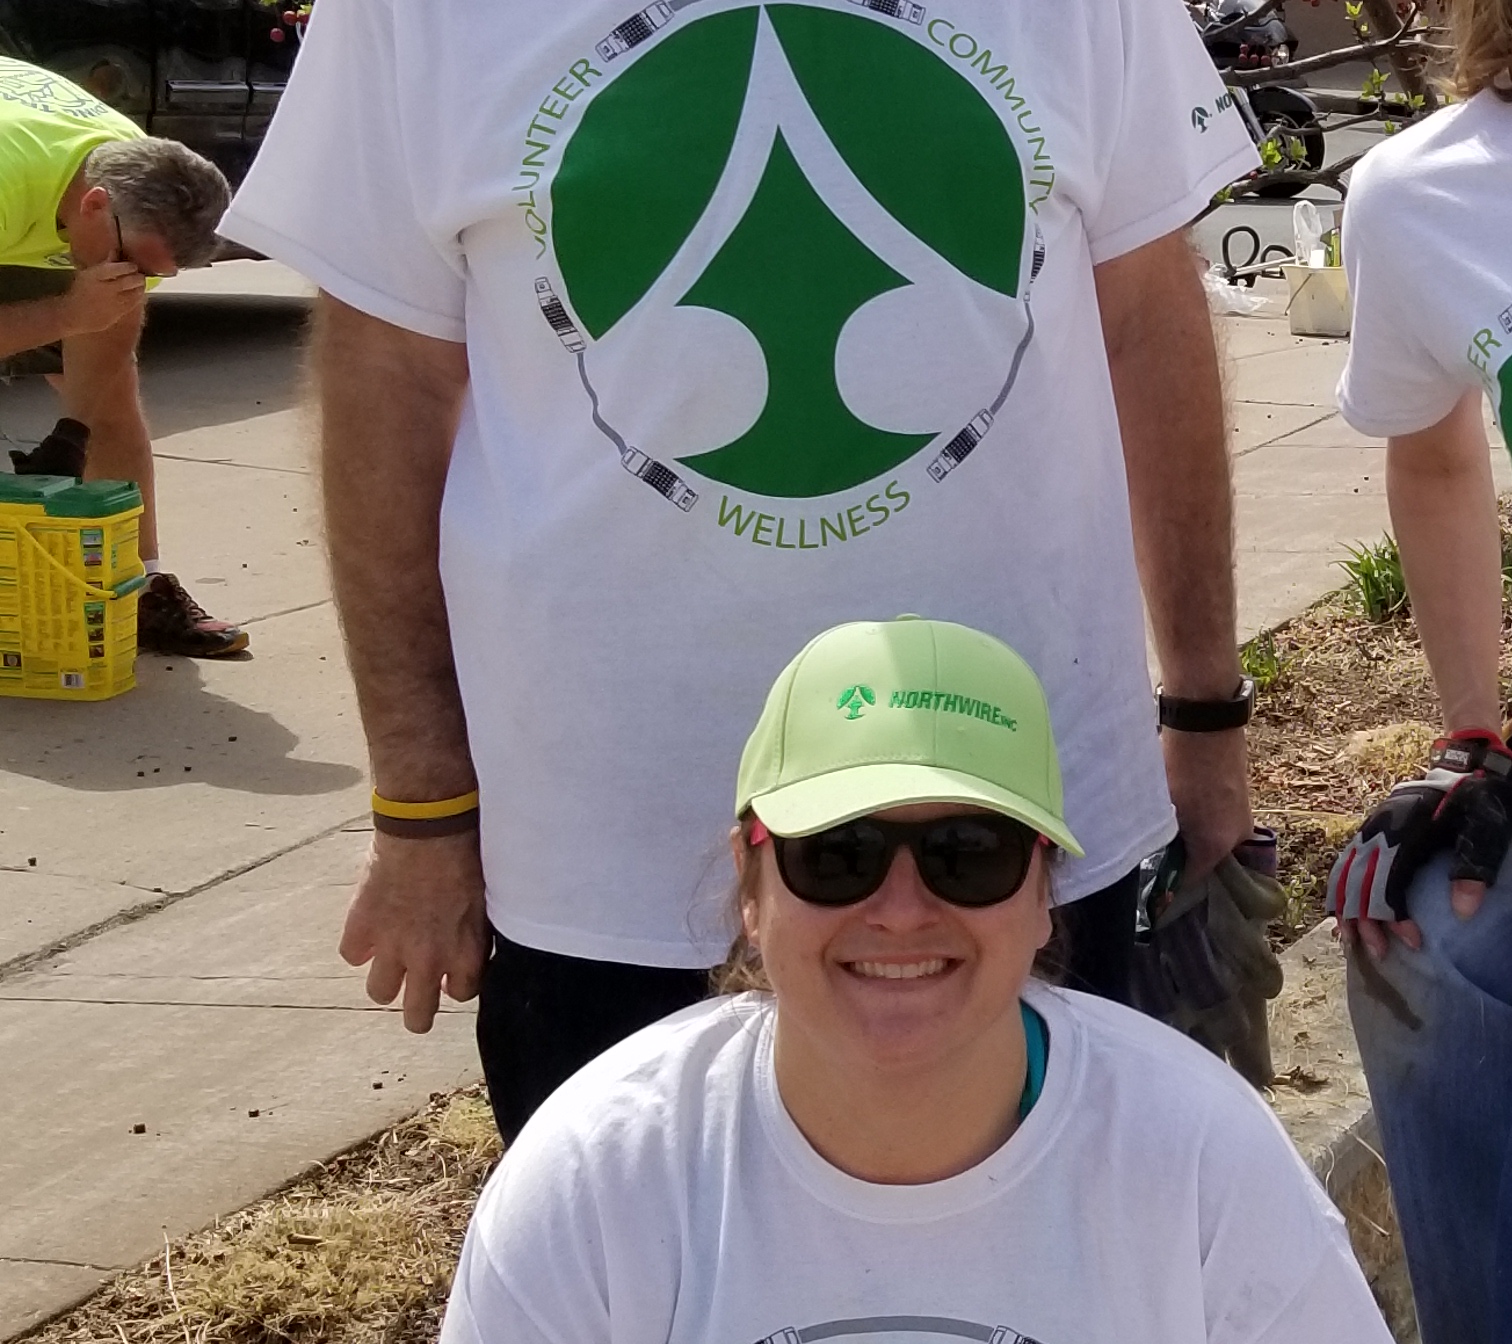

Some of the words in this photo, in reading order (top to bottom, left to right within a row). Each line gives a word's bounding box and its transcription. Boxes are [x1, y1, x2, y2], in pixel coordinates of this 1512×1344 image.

[511, 58, 603, 260] VOLUNTEER
[927, 18, 1056, 216] COMMUNITY
[717, 480, 911, 550] WELLNESS
[888, 690, 1003, 726] NORTHWIRE
